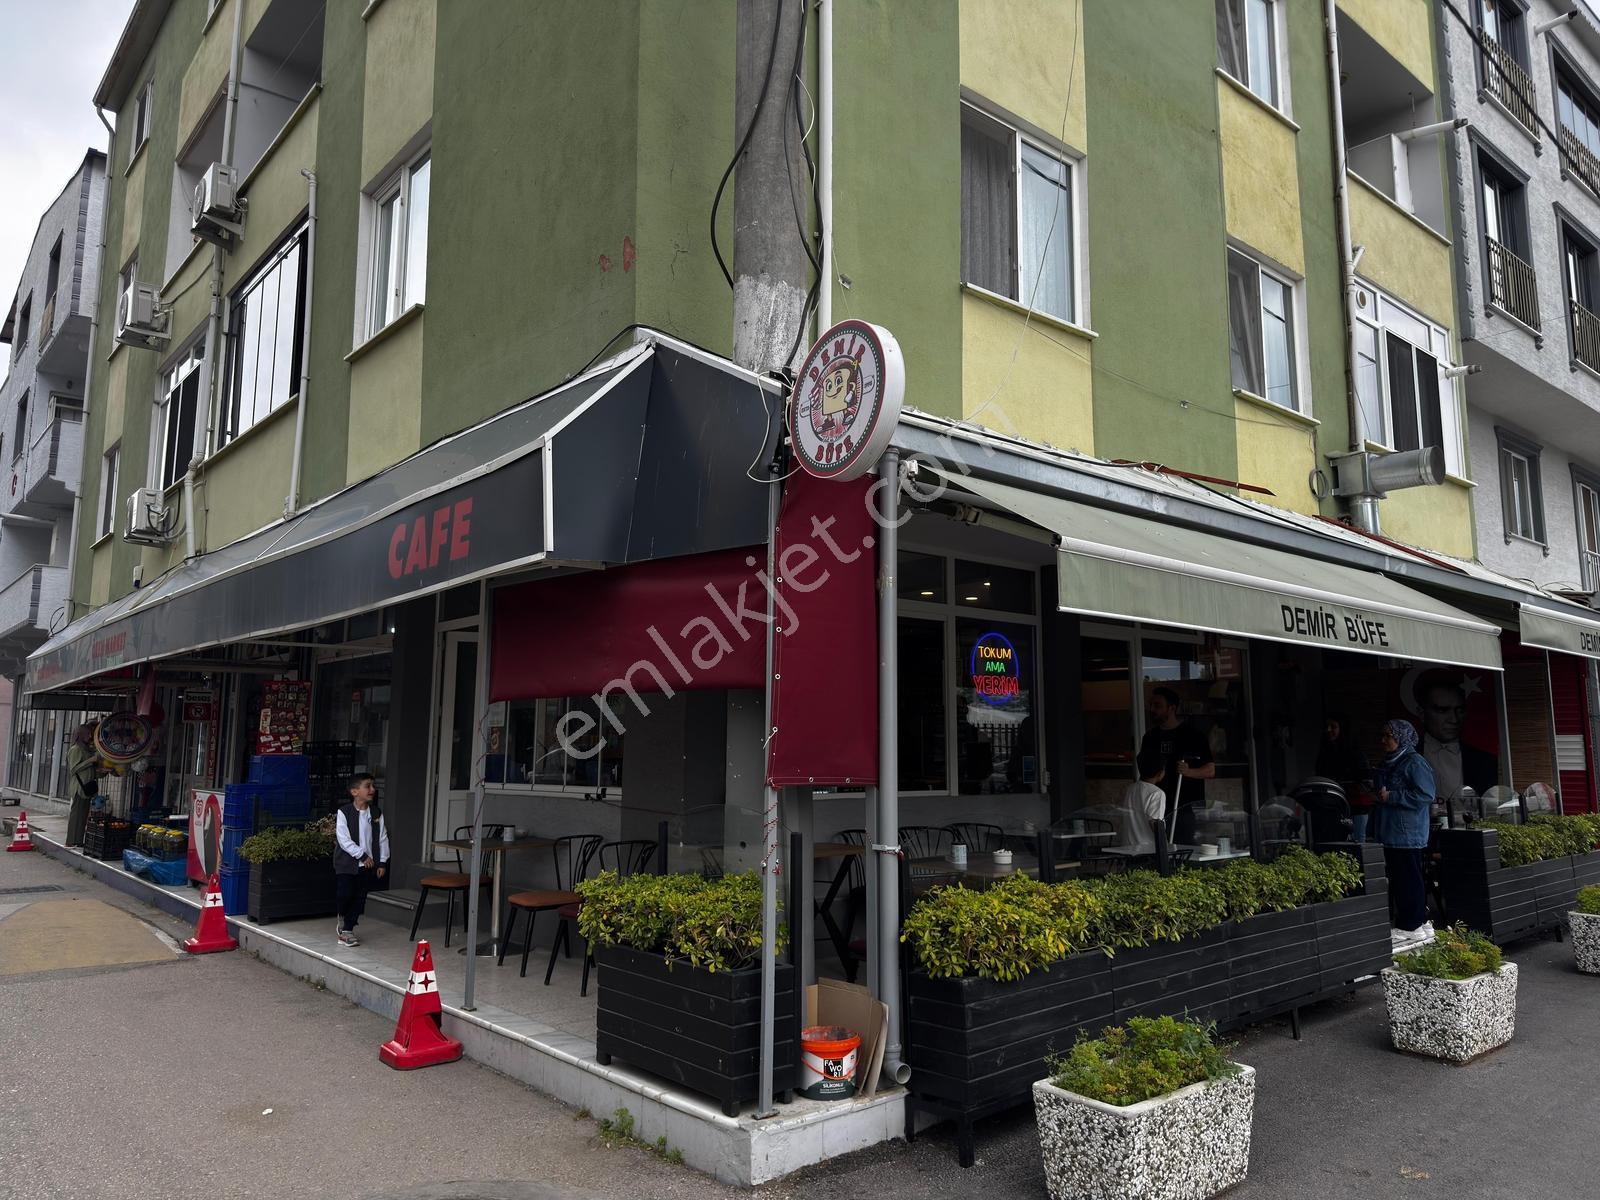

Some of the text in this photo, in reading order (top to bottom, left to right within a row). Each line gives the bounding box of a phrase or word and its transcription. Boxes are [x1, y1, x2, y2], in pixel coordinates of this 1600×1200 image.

[815, 435, 855, 464] BÜFE
[388, 496, 473, 579] CAFE
[1281, 605, 1389, 647] DEMİR BÜFE
[978, 645, 1012, 660] TOKUM
[1580, 630, 1600, 653] DEMİ
[985, 661, 1006, 673] AMA
[972, 674, 1020, 696] YERİM
